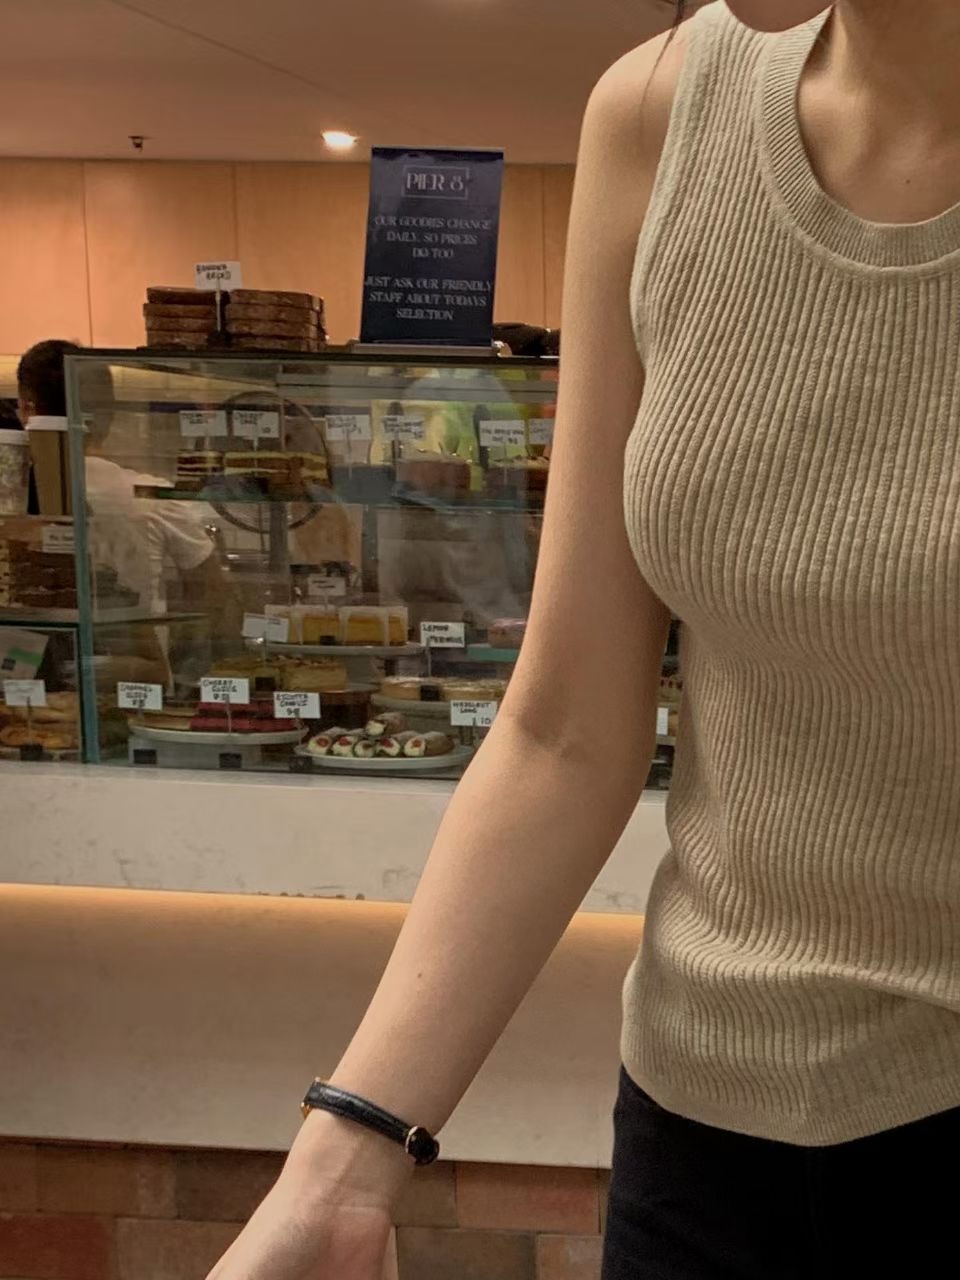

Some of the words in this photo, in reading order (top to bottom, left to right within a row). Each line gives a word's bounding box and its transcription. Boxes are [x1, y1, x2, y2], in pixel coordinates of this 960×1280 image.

[406, 172, 445, 191] PIER
[375, 215, 397, 226] OUR
[399, 216, 445, 228] GOODIES
[447, 218, 492, 230] CHANGE
[423, 232, 439, 243] SO
[441, 233, 478, 245] PRICES
[412, 247, 429, 258] DO
[431, 248, 453, 259] TOO
[365, 276, 391, 287] JUST
[393, 277, 413, 288] ASK
[416, 278, 439, 290] OUR
[442, 279, 491, 292] FRIENDLY
[369, 291, 403, 303] STAFF
[406, 293, 441, 305] ABOUT
[396, 308, 454, 321] SELECTION
